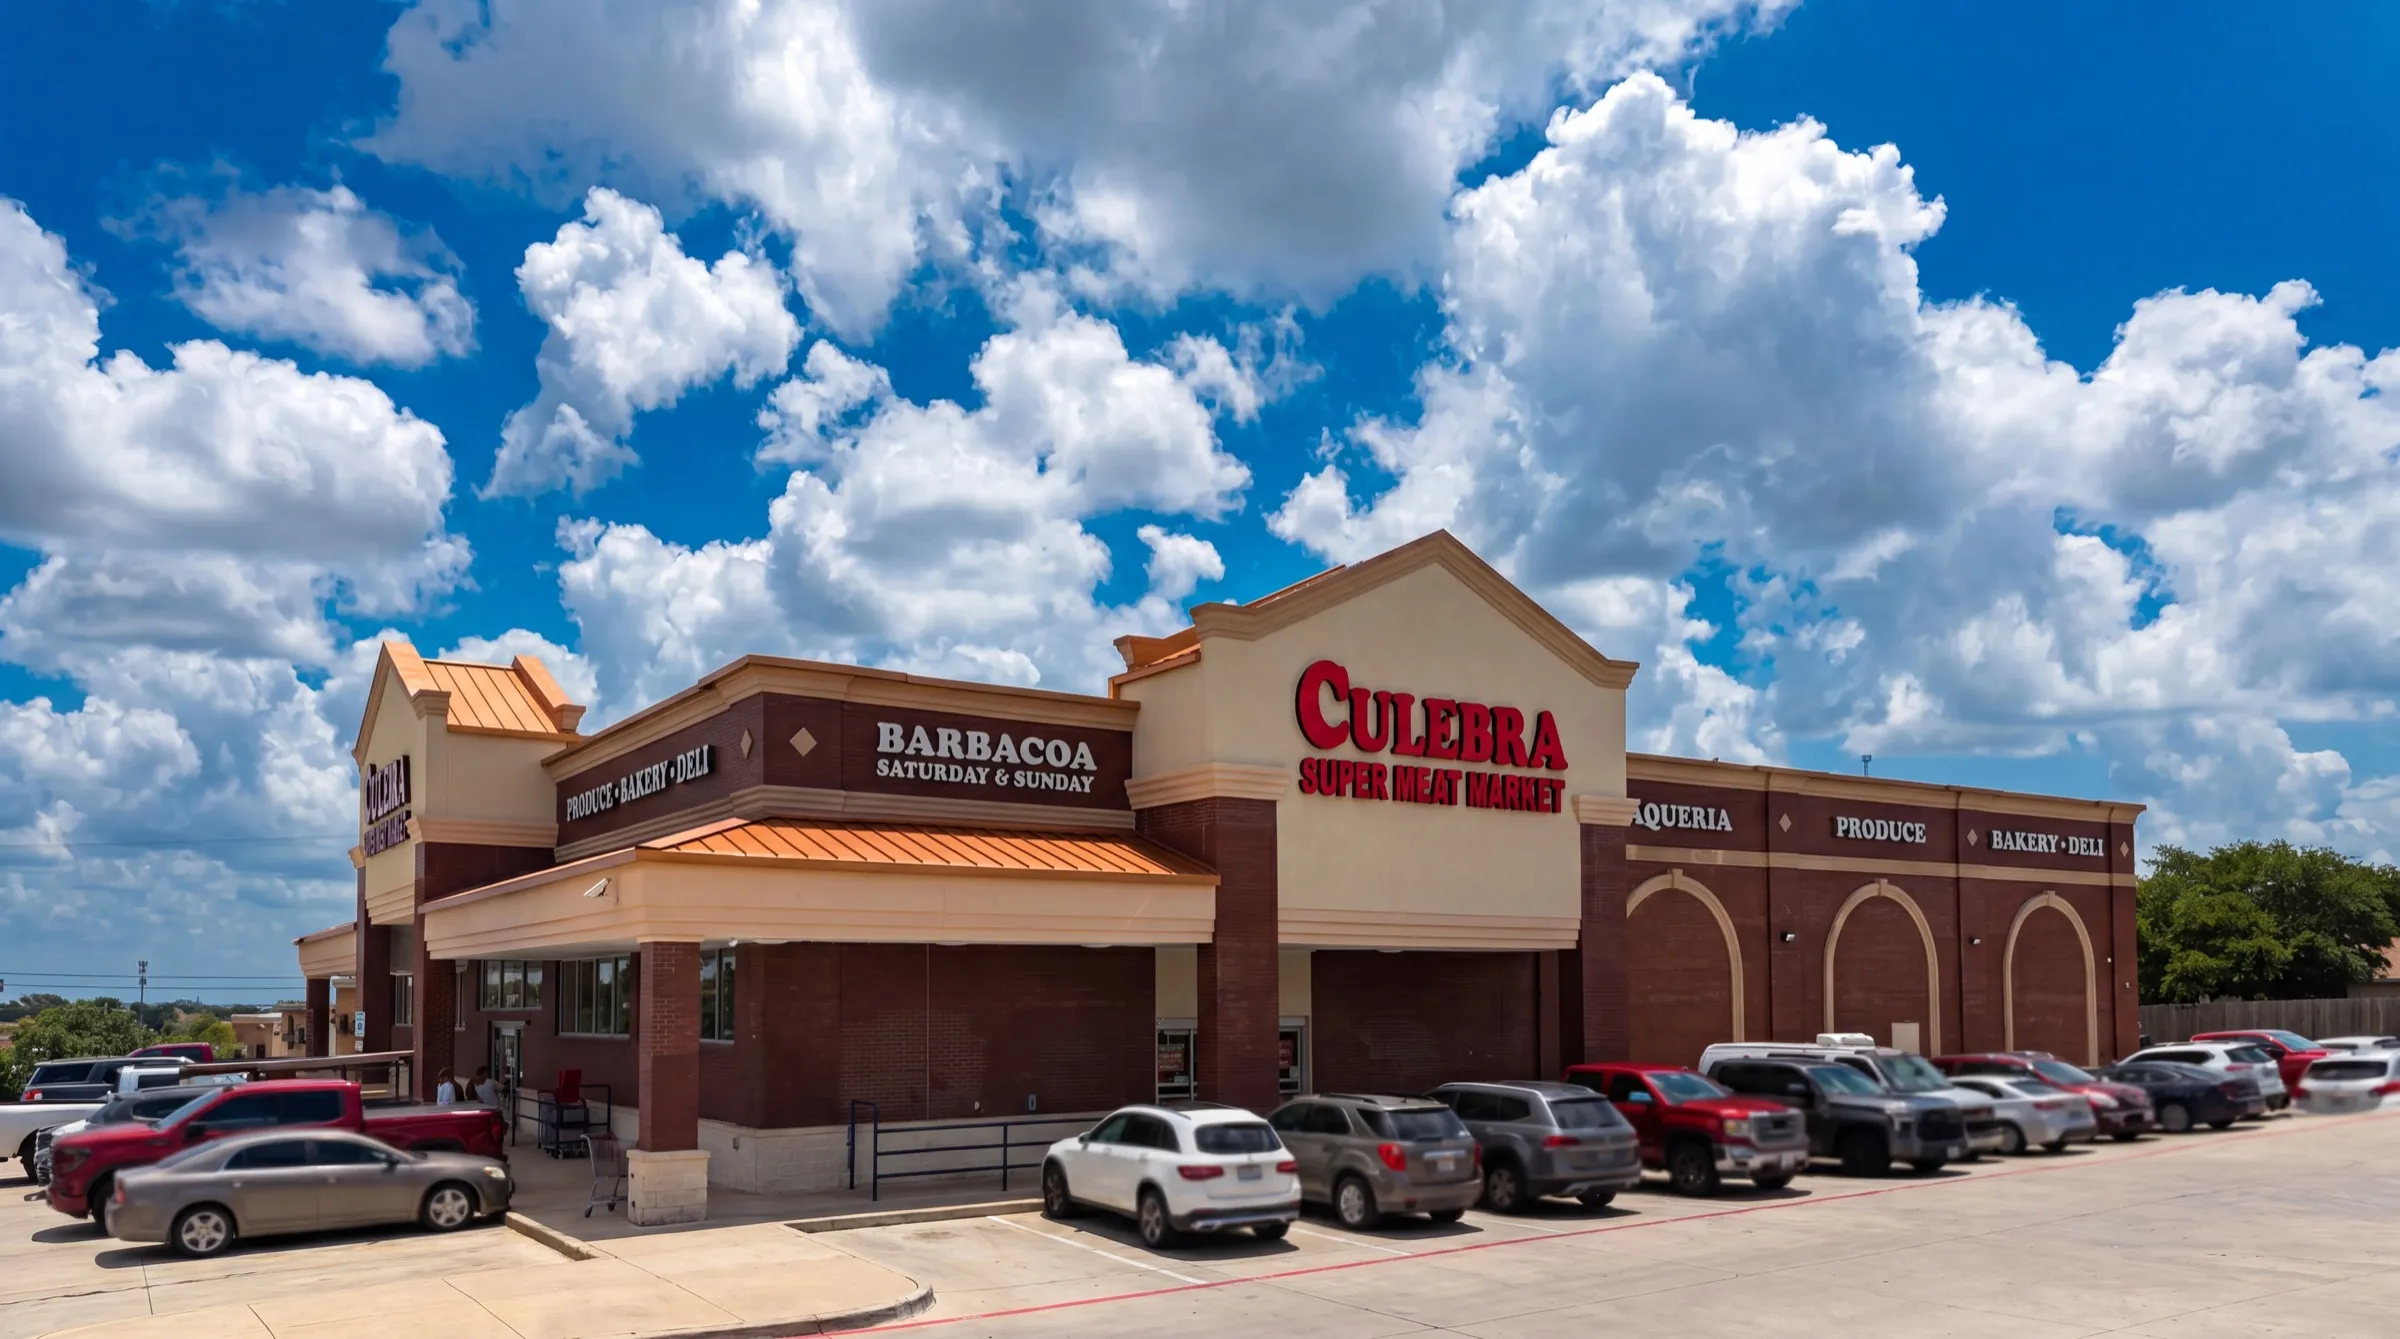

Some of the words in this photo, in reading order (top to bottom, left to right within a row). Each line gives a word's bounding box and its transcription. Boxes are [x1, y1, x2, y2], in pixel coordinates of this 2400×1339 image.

[1295, 659, 1568, 770] CULEBRA
[876, 721, 1098, 771] BARBACOA
[566, 781, 613, 822] PRODUCE
[620, 759, 669, 805] BAKERY
[676, 743, 710, 785] DELI
[876, 758, 990, 785] SATURDAY
[994, 768, 1010, 786] &
[1013, 770, 1095, 793] SUNDAY
[1299, 757, 1389, 801] SUPER
[1392, 764, 1462, 806] MEAT
[1465, 771, 1566, 814] MARKET
[1632, 802, 1733, 832] AQUERIA
[1836, 816, 1927, 844] PRODUCE
[1991, 830, 2059, 854] BAKERY
[2067, 836, 2104, 857] DELI
